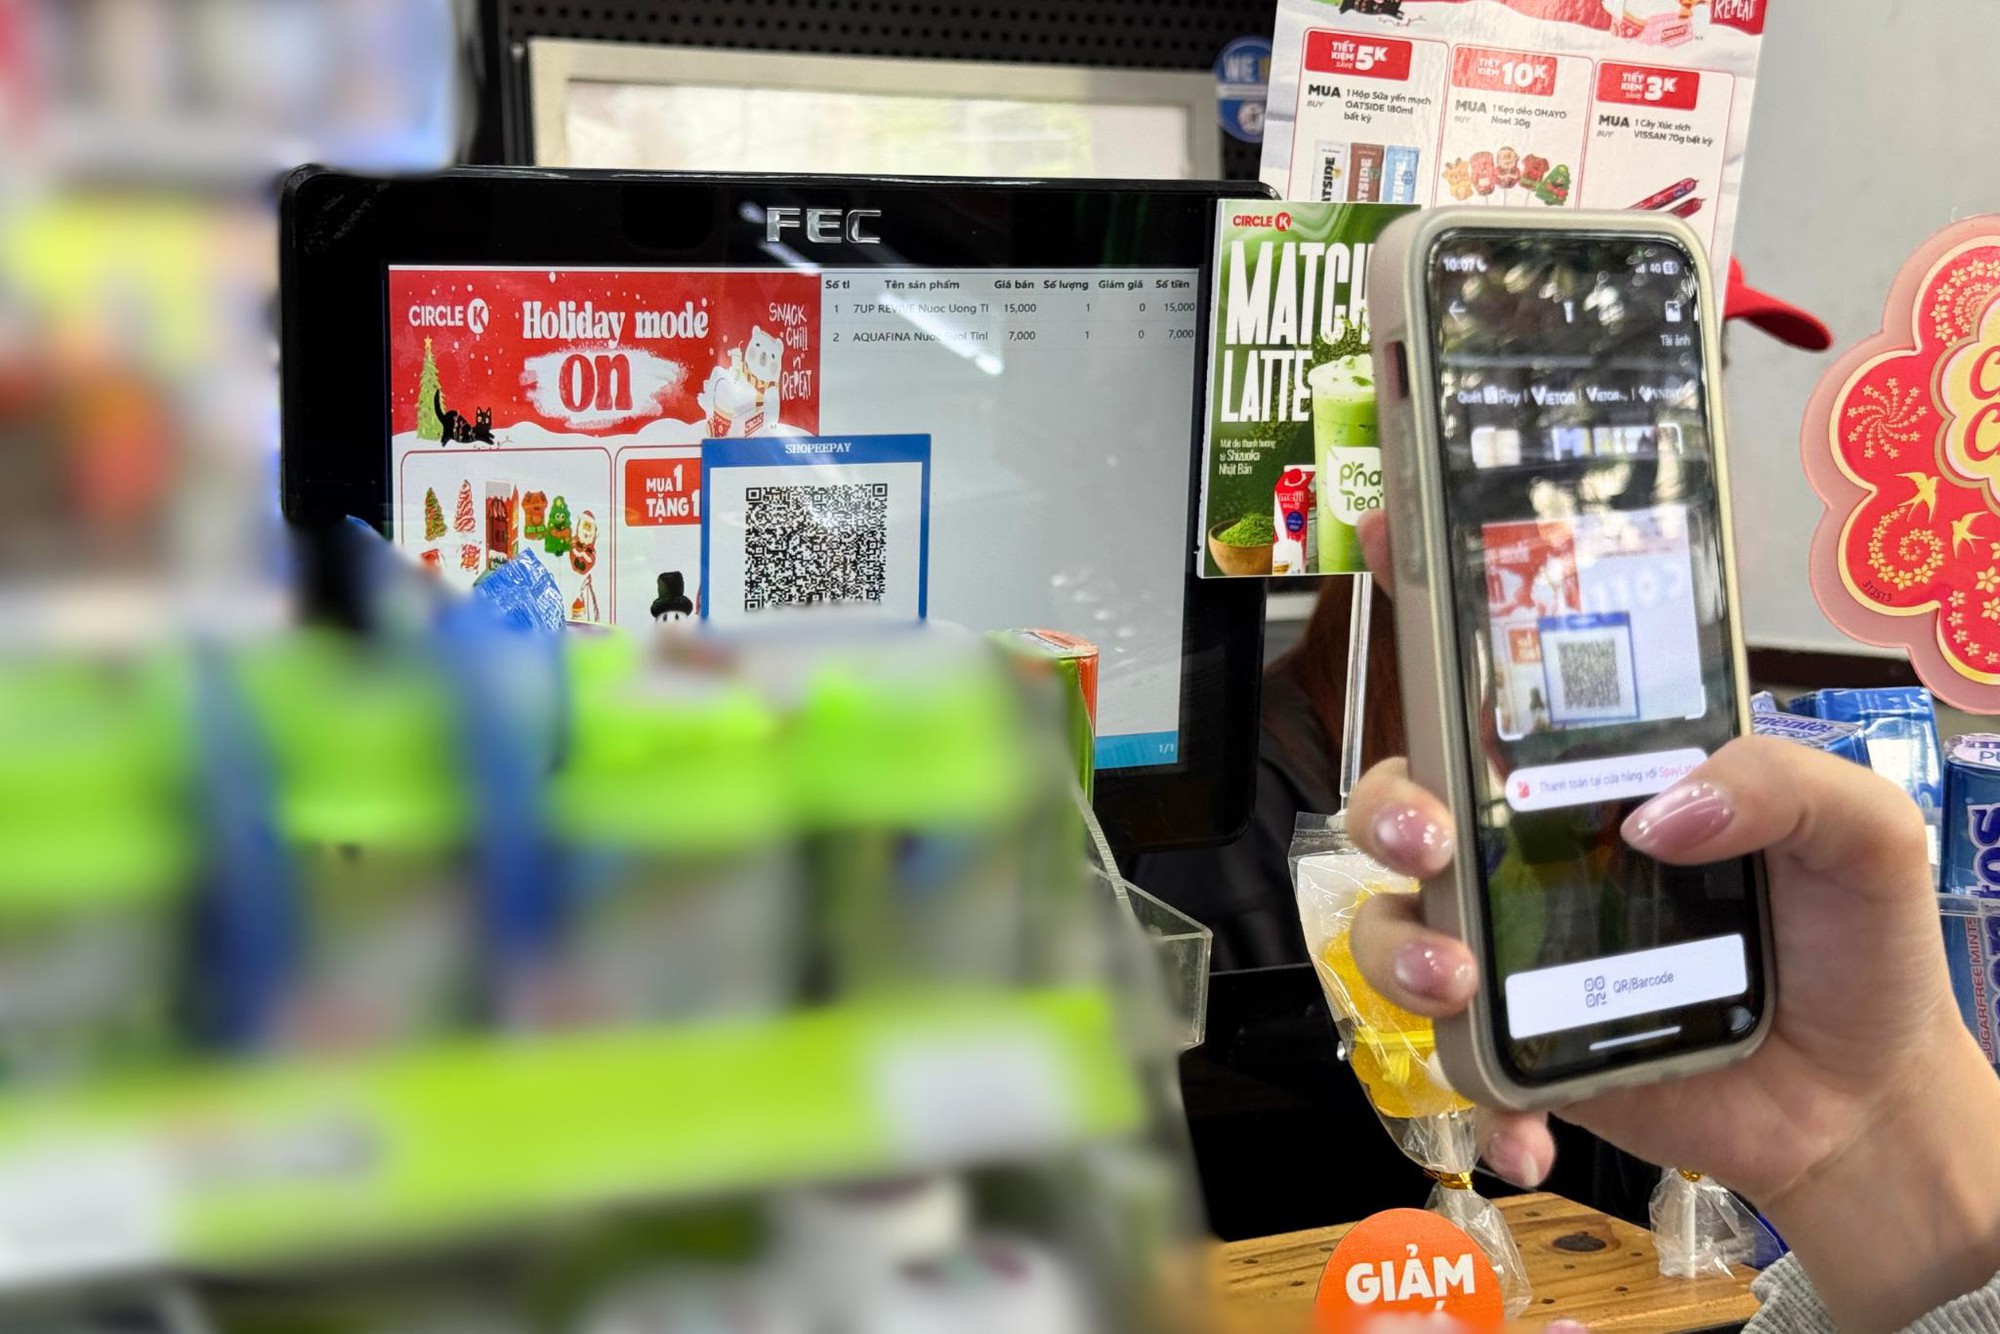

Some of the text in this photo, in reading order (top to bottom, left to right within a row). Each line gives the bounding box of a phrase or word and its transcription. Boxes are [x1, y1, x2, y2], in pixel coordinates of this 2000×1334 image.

[1354, 44, 1389, 71] 5K
[1501, 62, 1548, 89] 10K
[1308, 84, 1341, 99] MUA
[1643, 75, 1678, 101] 3K
[1306, 100, 1413, 115] BUY OATSIDE 180ml
[1455, 99, 1487, 114] MUA
[1599, 114, 1630, 128] MUA
[1634, 130, 1666, 141] VISSAN
[767, 208, 881, 243] FEC
[1232, 215, 1273, 227] CIRCLE
[885, 280, 905, 289] Tên
[994, 280, 1012, 289] Giá
[1014, 280, 1035, 289] bán
[1059, 280, 1089, 291] lượng
[1127, 280, 1144, 291] giá
[409, 306, 463, 327] CIRCLE
[769, 302, 807, 326] SNACK
[834, 305, 839, 313] 1
[854, 305, 874, 313] 7UP
[918, 304, 946, 313] Nuoc
[949, 304, 976, 315] Uong
[1004, 304, 1037, 314] 15,000
[1086, 304, 1091, 312] 1
[1139, 303, 1146, 312] 0
[1164, 302, 1195, 313] 15,000
[522, 301, 709, 349] Holiday mode
[833, 333, 839, 342] 2
[853, 333, 911, 343] AQUAFINA
[1008, 331, 1036, 342] 7,000
[1085, 331, 1090, 339] 1
[1138, 330, 1144, 339] 0
[1168, 329, 1194, 340] 7,000
[559, 353, 633, 412] on
[782, 370, 812, 400] REPEAT
[1220, 350, 1313, 422] LATTE
[785, 443, 851, 454] SHOPEEPAY
[646, 464, 683, 492] MUA 1
[646, 493, 688, 523] TẶNG
[1159, 744, 1174, 753] 1/1
[1613, 971, 1674, 993] QR/Barcode
[1966, 917, 1994, 1064] SUGARFREE MINTS
[1345, 1243, 1475, 1305] GIẢM
